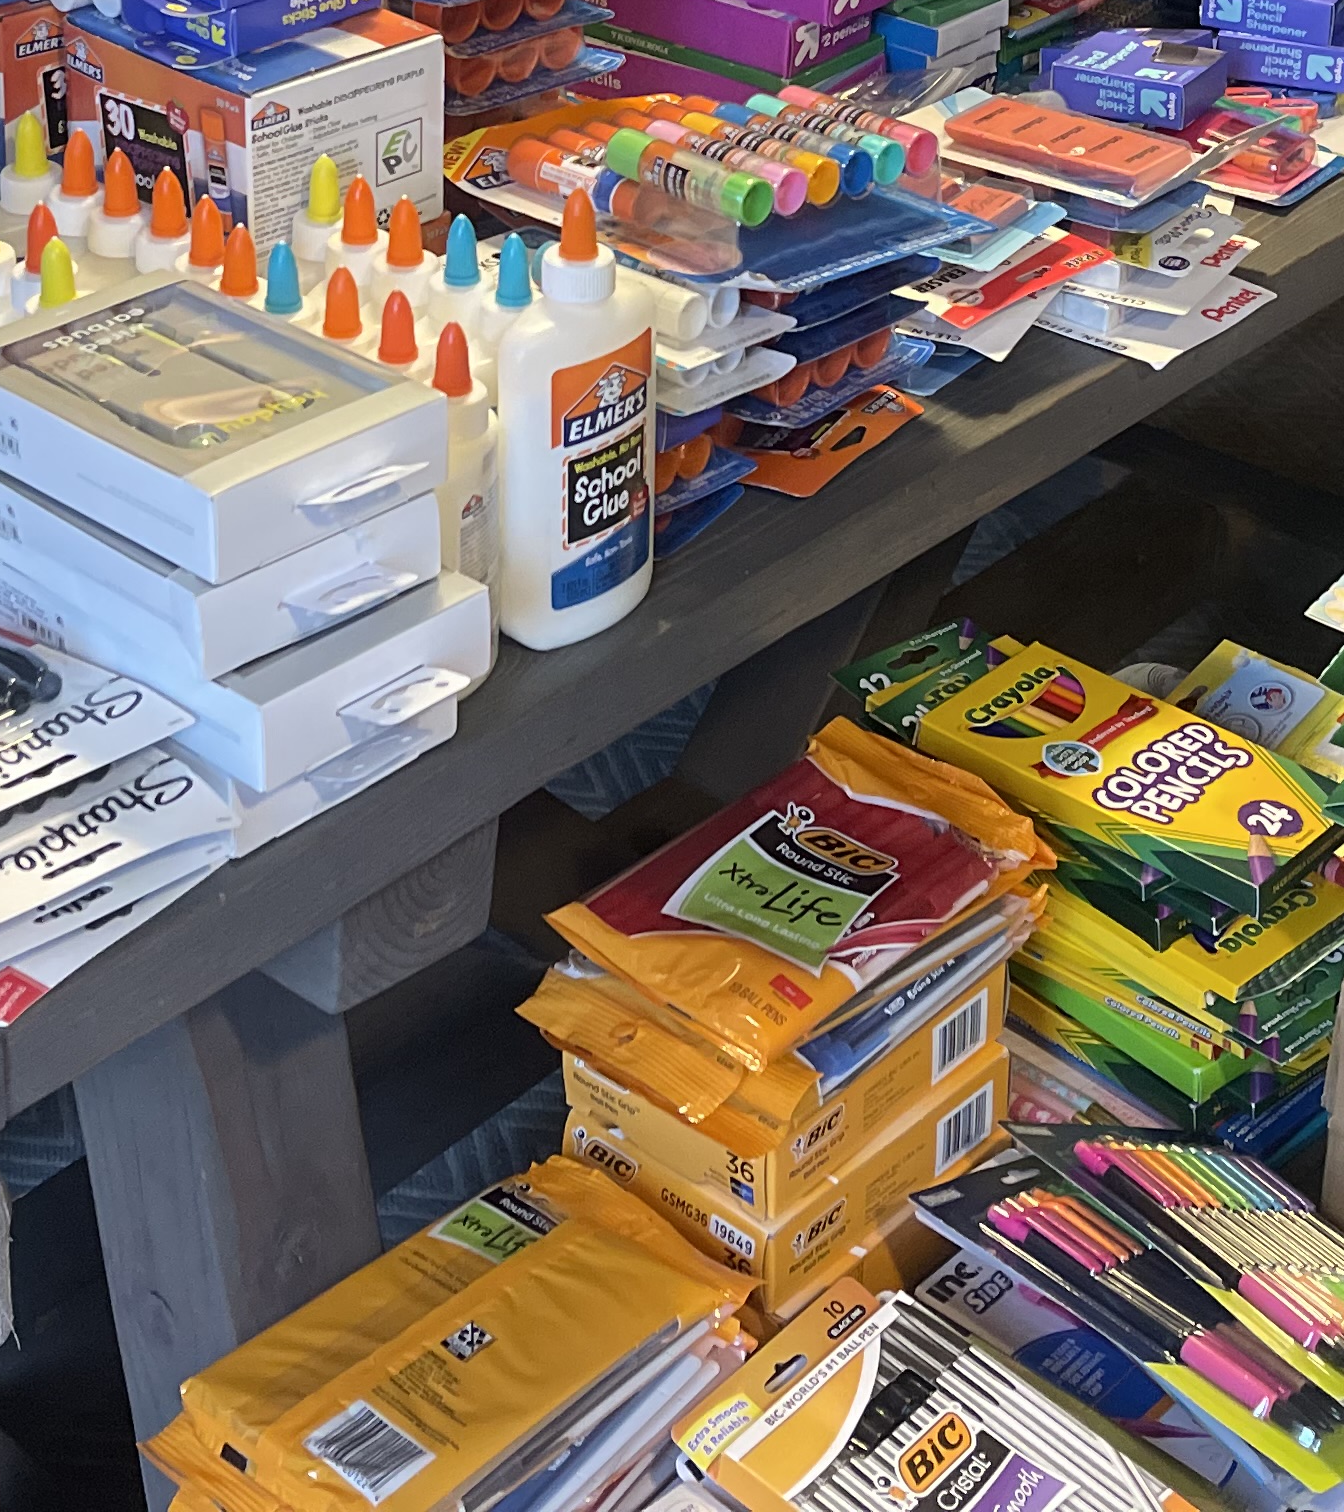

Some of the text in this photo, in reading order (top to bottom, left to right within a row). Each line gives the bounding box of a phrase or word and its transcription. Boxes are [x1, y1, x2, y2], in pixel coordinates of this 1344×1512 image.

[1245, 18, 1308, 39] Sharpener
[1247, 9, 1283, 24] Pencil
[1238, 39, 1303, 60] Sharpener
[1264, 54, 1301, 70] Pencil
[1074, 73, 1136, 94] Sharpener
[1260, 65, 1301, 80] 2-Hole
[1095, 98, 1136, 115] 2-Hole
[1099, 88, 1136, 105] Pencil
[105, 99, 135, 141] 30
[1199, 239, 1248, 268] Pentel
[1200, 288, 1264, 323] Pentel
[42, 307, 145, 350] earbuds
[568, 386, 645, 442] ELMER'S
[573, 445, 642, 504] School
[582, 489, 630, 527] Glue
[964, 665, 1058, 726] Crayola
[1095, 723, 1218, 810] COLORED
[1131, 741, 1252, 824] PENCILS
[1246, 801, 1295, 837] 24
[776, 841, 856, 886] Round Stic
[805, 834, 887, 871] BIC
[737, 908, 771, 931] Long
[761, 881, 843, 927] Life
[1218, 889, 1319, 954] Crayola
[739, 986, 788, 1027] BALL PENS
[1104, 996, 1181, 1041] Colored Pencils
[1136, 994, 1213, 1039] Colored Pencils
[573, 1071, 600, 1094] Round
[807, 1110, 841, 1148] BIC
[588, 1144, 633, 1178] BIC
[725, 1150, 755, 1184] 36
[499, 1197, 536, 1221] Round
[660, 1187, 709, 1228] GSMG36
[807, 1205, 841, 1244] BIC
[714, 1218, 754, 1256] 19649
[822, 1299, 845, 1320] 10
[962, 1270, 1008, 1314] SIDE
[829, 1306, 865, 1338] BLACK INK
[826, 1322, 880, 1377] #1 BALL PEN
[686, 1398, 750, 1454] Extra Smooth
[701, 1415, 751, 1456] & Reliable
[904, 1417, 959, 1489] BIC
[936, 1451, 993, 1512] Cristal
